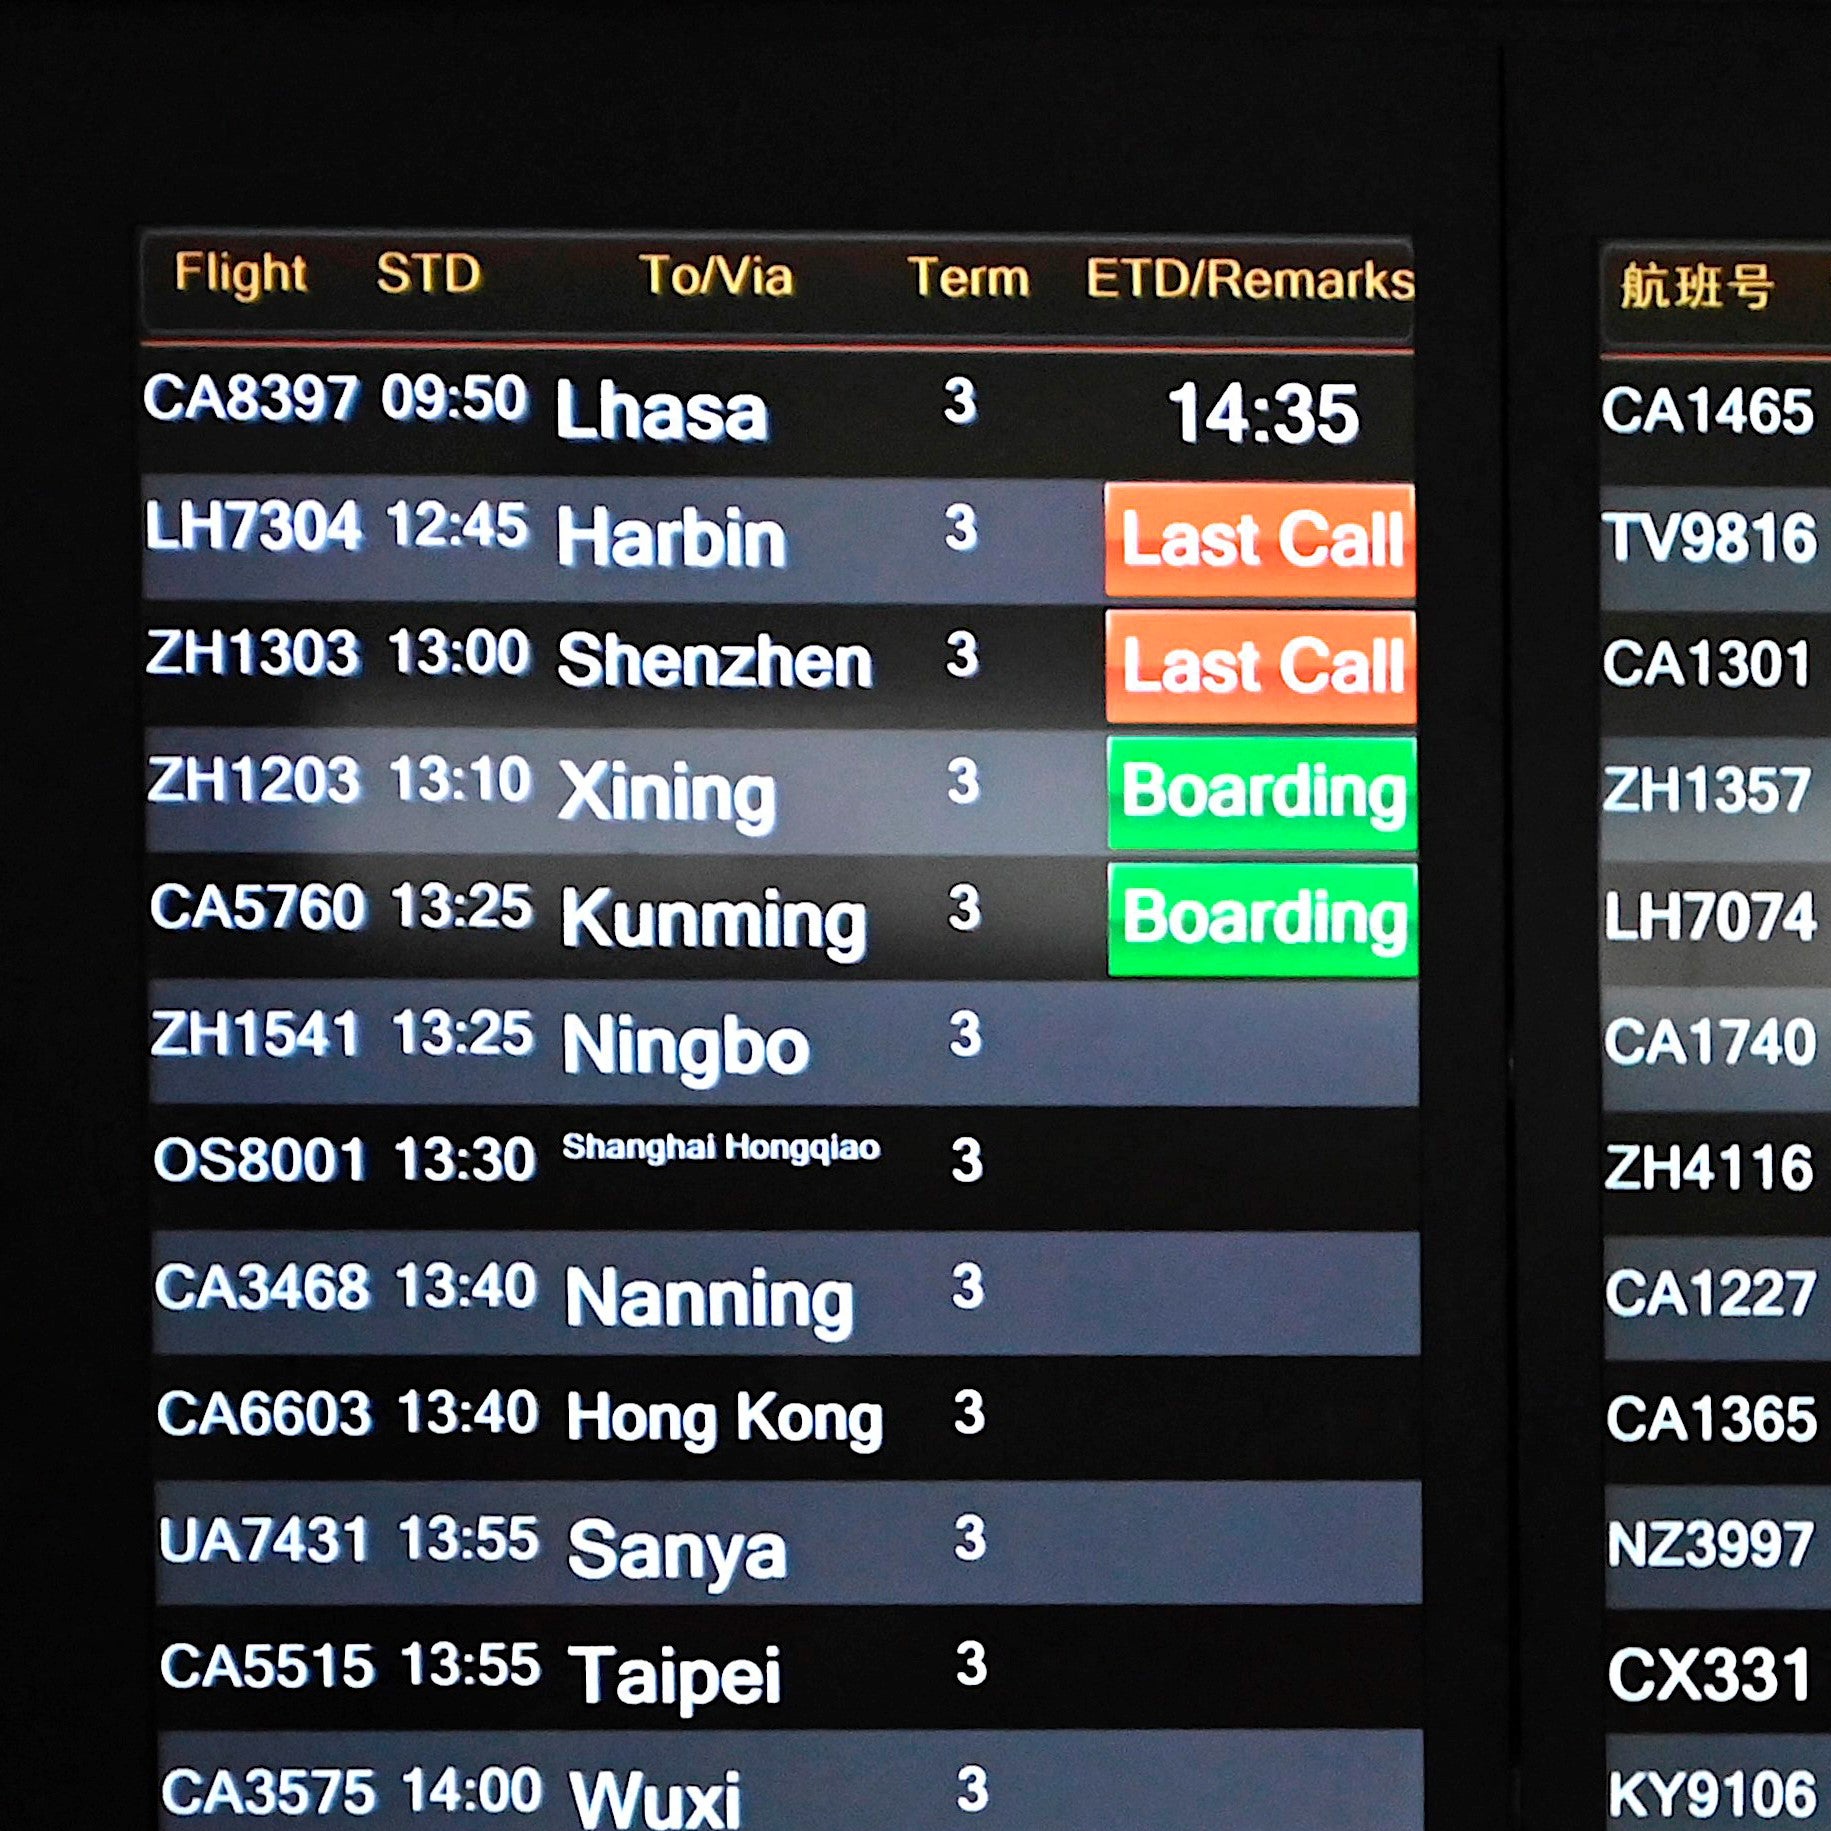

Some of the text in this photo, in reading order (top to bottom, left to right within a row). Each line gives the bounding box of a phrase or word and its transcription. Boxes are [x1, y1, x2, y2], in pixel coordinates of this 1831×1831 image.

[175, 250, 1416, 304] Flight STD To/Via Term ETD/Remarks
[1621, 260, 1775, 311] 航班号
[142, 371, 1360, 445] CA8397 09:50 Lhasa 3 14:35
[1601, 385, 1815, 436] CA1465
[145, 498, 1405, 570] LH7304 12:45 Harbin 3 Last Call
[1600, 510, 1818, 565] TV9816
[144, 627, 1405, 695] ZH1303 13:00 Shenzhen 3 Last Call
[146, 753, 1407, 839] ZH1203 13:10 Xining 3 Boarding
[149, 880, 1408, 965] CA5760 13:25 Kunming 3 Boarding
[1605, 889, 1819, 943] LH7074
[153, 1132, 984, 1184] OS8001 13:30 Shanghai Hongqiao 3
[1603, 1142, 1815, 1193] ZH4116
[1605, 1267, 1818, 1318] CA1227
[156, 1387, 986, 1455] CA6603 13:40 Hong Kong 3
[159, 1513, 988, 1596] UA7431 13:55 Sanya 3
[1608, 1518, 1815, 1569] NZ3997
[159, 1639, 989, 1720] CA5515 13:55 Taipei 3
[1607, 1645, 1809, 1703] CX331
[1609, 1768, 1818, 1820] KY9106
